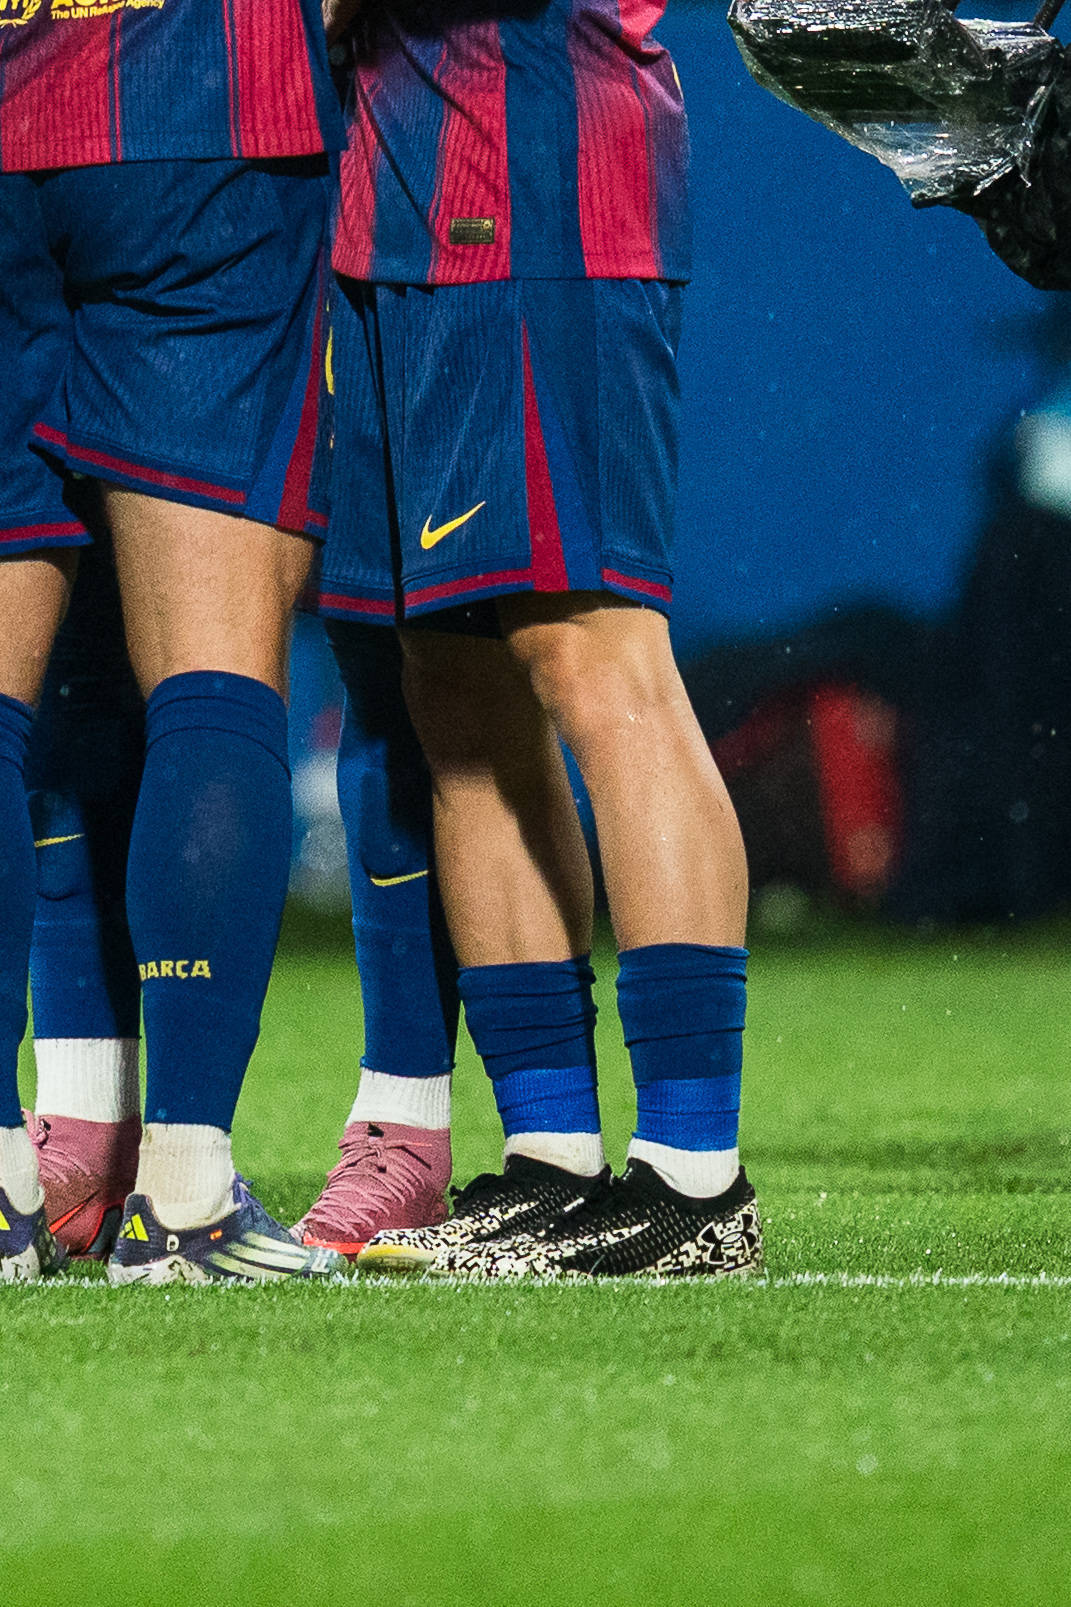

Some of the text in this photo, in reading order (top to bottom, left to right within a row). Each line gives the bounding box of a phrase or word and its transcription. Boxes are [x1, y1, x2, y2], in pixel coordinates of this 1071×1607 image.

[51, 10, 70, 20] The
[71, 6, 89, 19] UN
[139, 960, 211, 980] BARÇA
